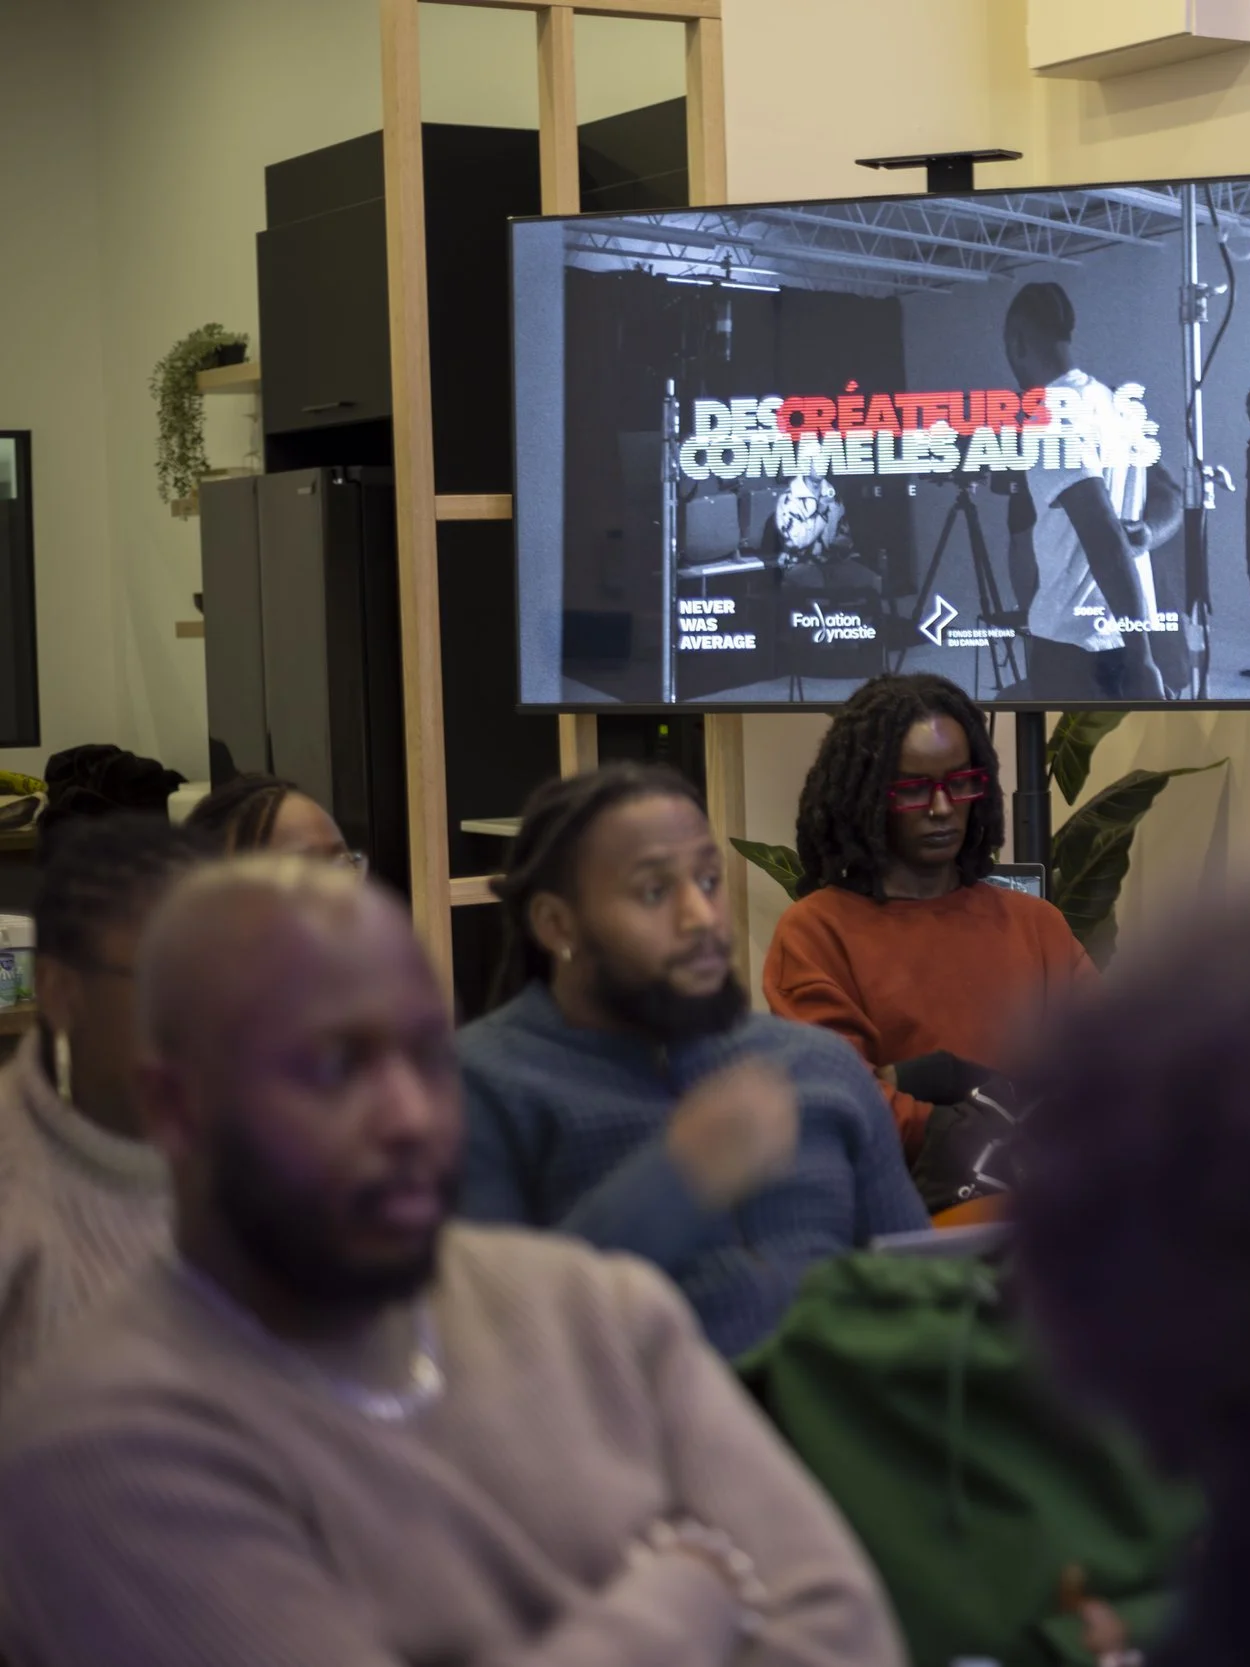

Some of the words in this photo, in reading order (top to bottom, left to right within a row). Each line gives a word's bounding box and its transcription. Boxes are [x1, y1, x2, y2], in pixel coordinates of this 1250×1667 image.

[695, 398, 784, 440] DES
[776, 380, 1052, 441] CRÉATEURS
[1044, 382, 1148, 432] PS
[679, 430, 875, 480] COMME
[877, 420, 961, 475] LES
[679, 599, 736, 615] NEVER
[679, 617, 718, 632] WAS
[947, 629, 972, 638] FONDS
[973, 629, 987, 638] DES
[679, 634, 757, 650] AVERAGE
[947, 638, 959, 647] DU
[960, 638, 990, 647] CANADA
